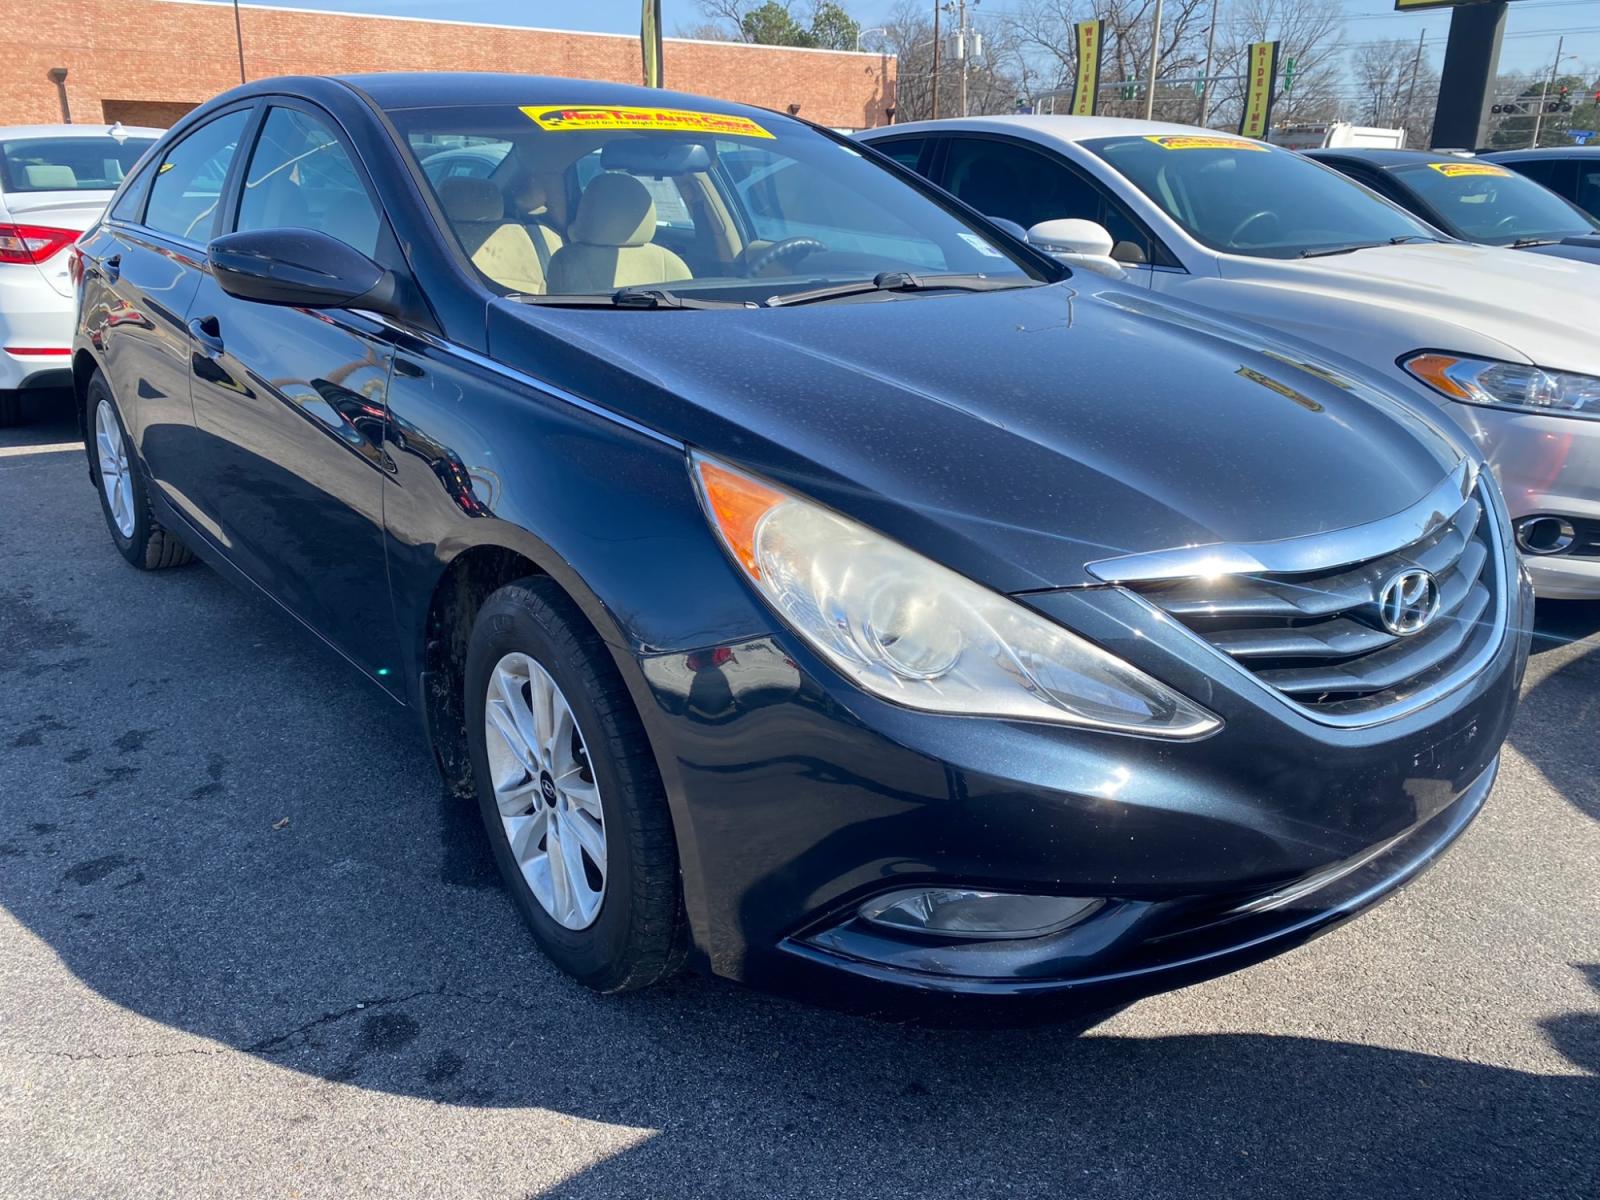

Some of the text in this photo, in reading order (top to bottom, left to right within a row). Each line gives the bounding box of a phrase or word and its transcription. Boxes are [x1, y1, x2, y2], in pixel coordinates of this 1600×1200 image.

[1080, 26, 1094, 113] WE FINANC
[1251, 47, 1266, 132] RIDE TIME
